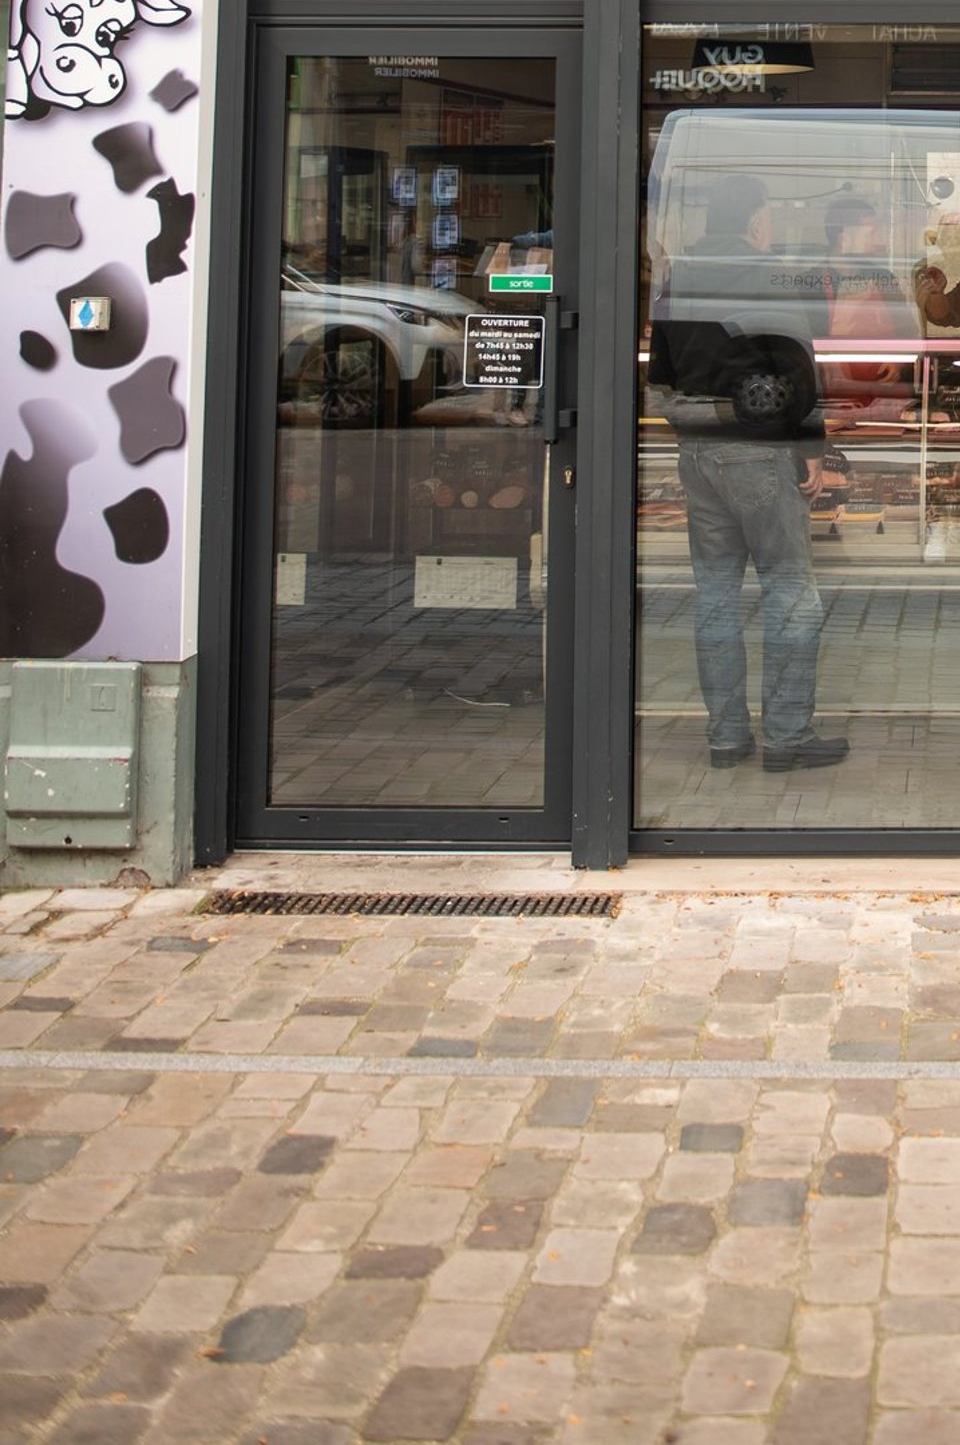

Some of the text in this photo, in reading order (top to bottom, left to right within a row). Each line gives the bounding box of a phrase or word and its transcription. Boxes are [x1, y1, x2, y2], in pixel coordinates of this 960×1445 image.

[509, 280, 533, 288] sortie
[482, 319, 529, 327] OUVERTURE
[469, 329, 479, 337] du
[485, 365, 522, 373] dimanche
